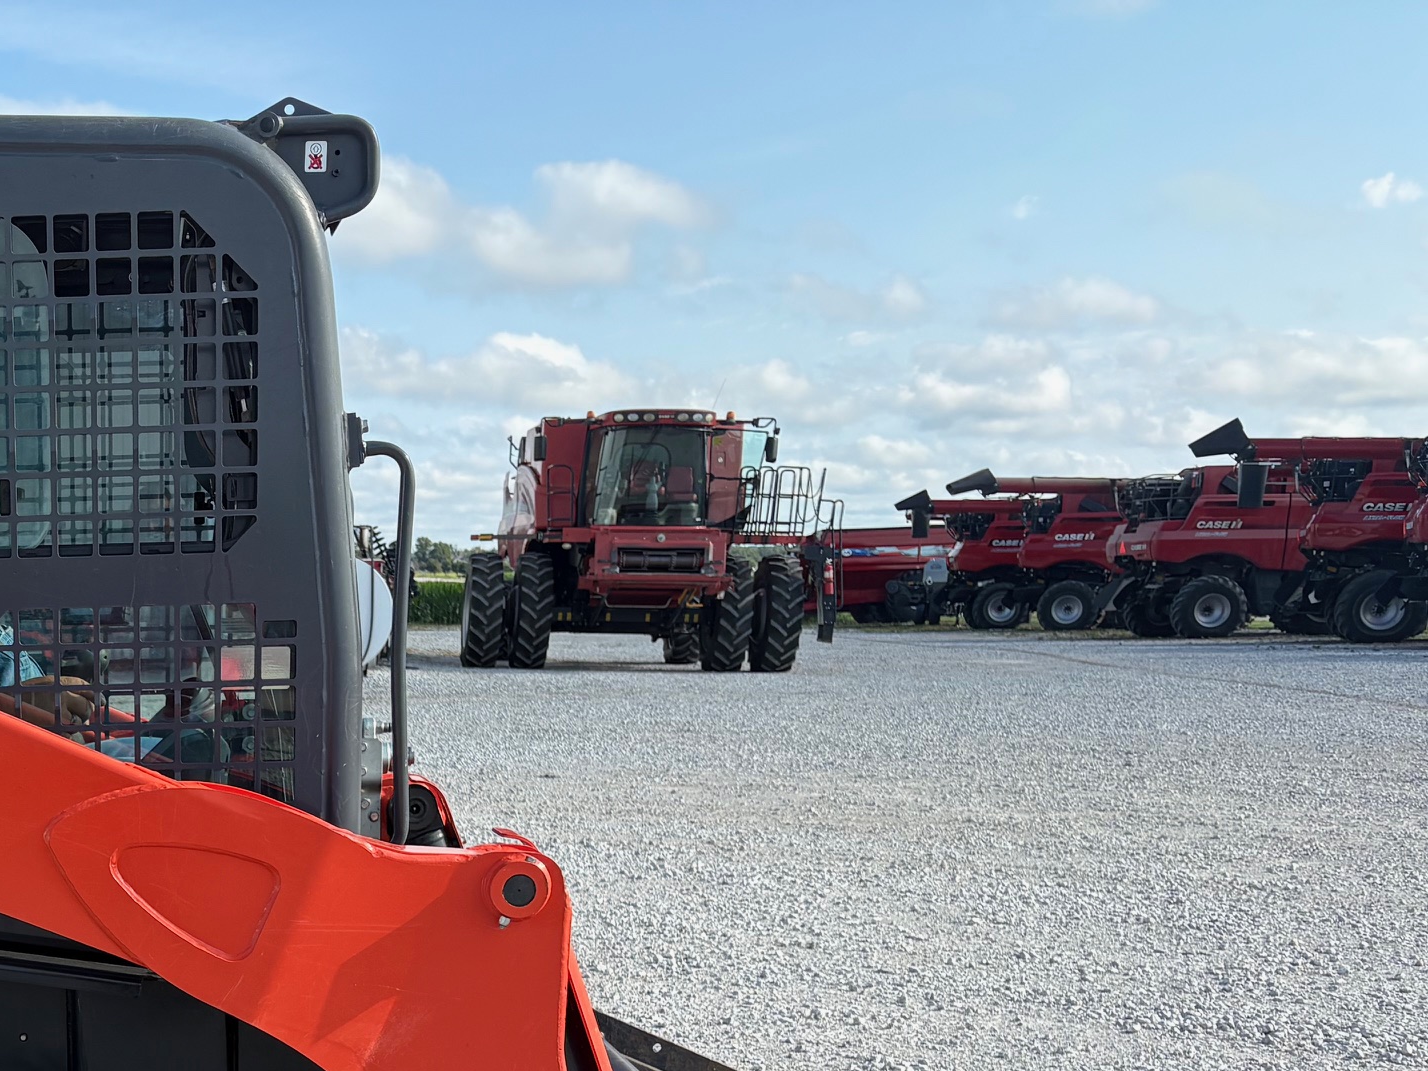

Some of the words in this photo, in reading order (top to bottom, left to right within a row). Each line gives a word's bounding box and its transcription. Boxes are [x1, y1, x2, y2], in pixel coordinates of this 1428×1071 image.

[1362, 502, 1406, 512] CASE
[1196, 520, 1231, 529] CASE
[1054, 533, 1084, 541] CASE
[992, 539, 1019, 547] CASE
